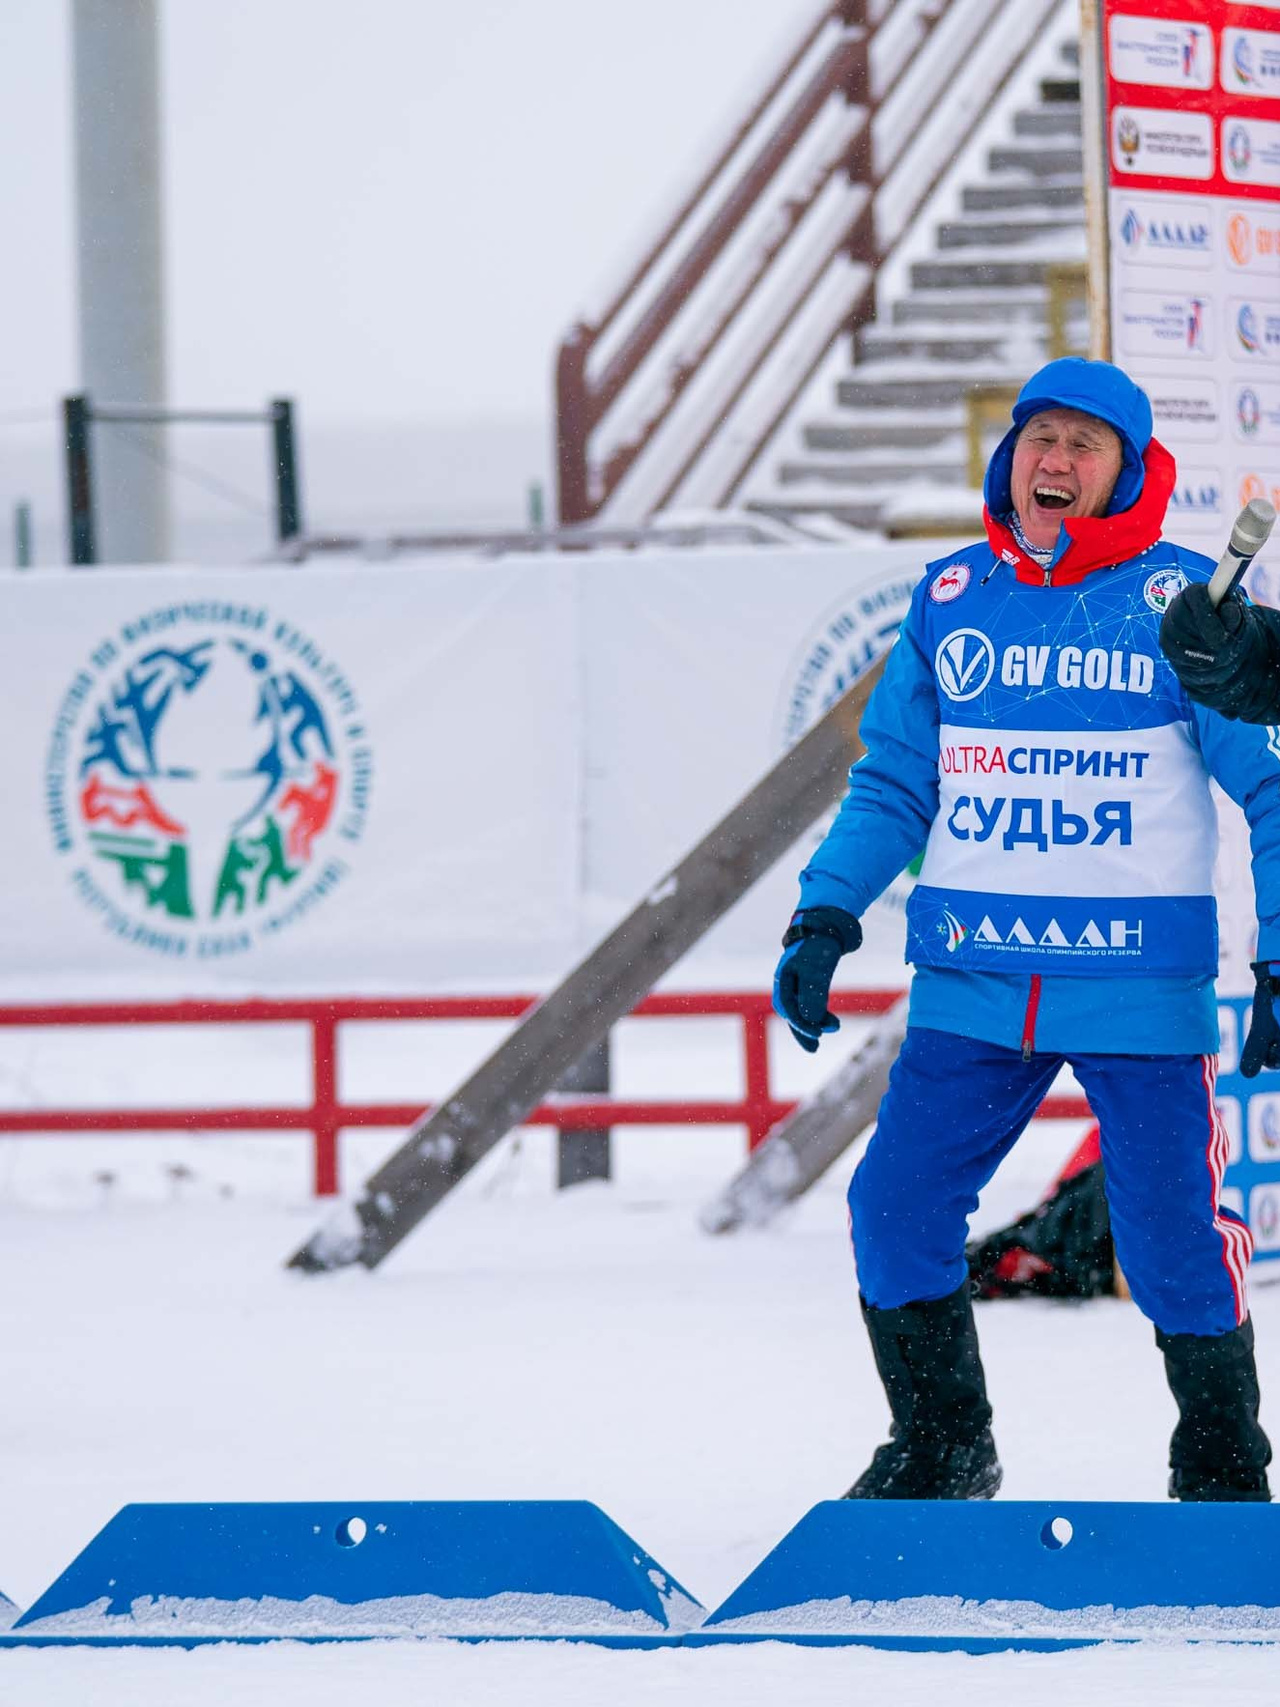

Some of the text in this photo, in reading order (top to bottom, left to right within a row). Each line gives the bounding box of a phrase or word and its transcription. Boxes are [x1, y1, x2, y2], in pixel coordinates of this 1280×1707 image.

[1001, 645, 1155, 695] GV GOLD
[940, 745, 1150, 778] ULTRAСПРИНТ
[947, 795, 1133, 853] СУДЬЯ
[973, 914, 1143, 948] АЛДАН
[1020, 946, 1046, 955] ШКОЛА
[1046, 948, 1107, 957] ОЛИМПИЙСКОГО
[1107, 949, 1142, 957] РЕЗЕРВА
